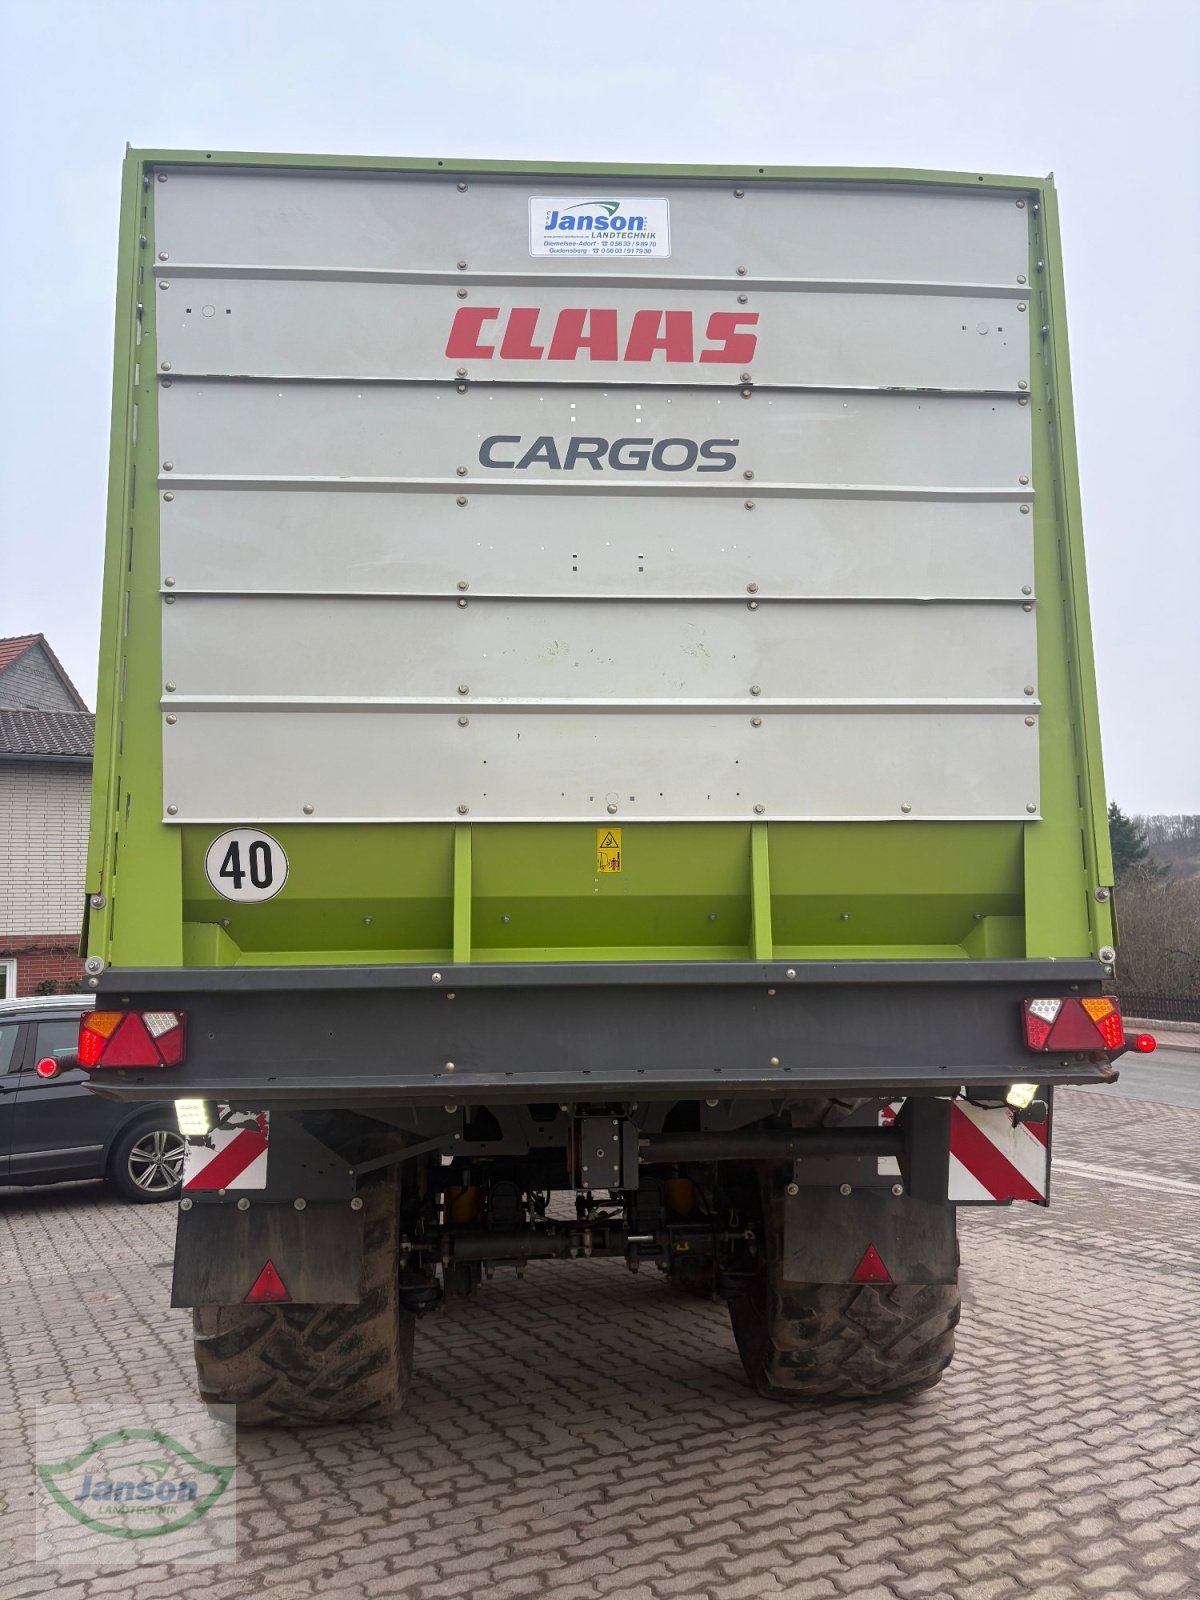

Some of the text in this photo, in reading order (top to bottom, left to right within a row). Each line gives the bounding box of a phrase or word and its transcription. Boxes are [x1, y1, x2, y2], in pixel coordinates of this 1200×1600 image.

[544, 210, 644, 231] Janson
[445, 307, 760, 364] CLAAS
[478, 435, 740, 472] CARGOS
[219, 840, 273, 889] 40
